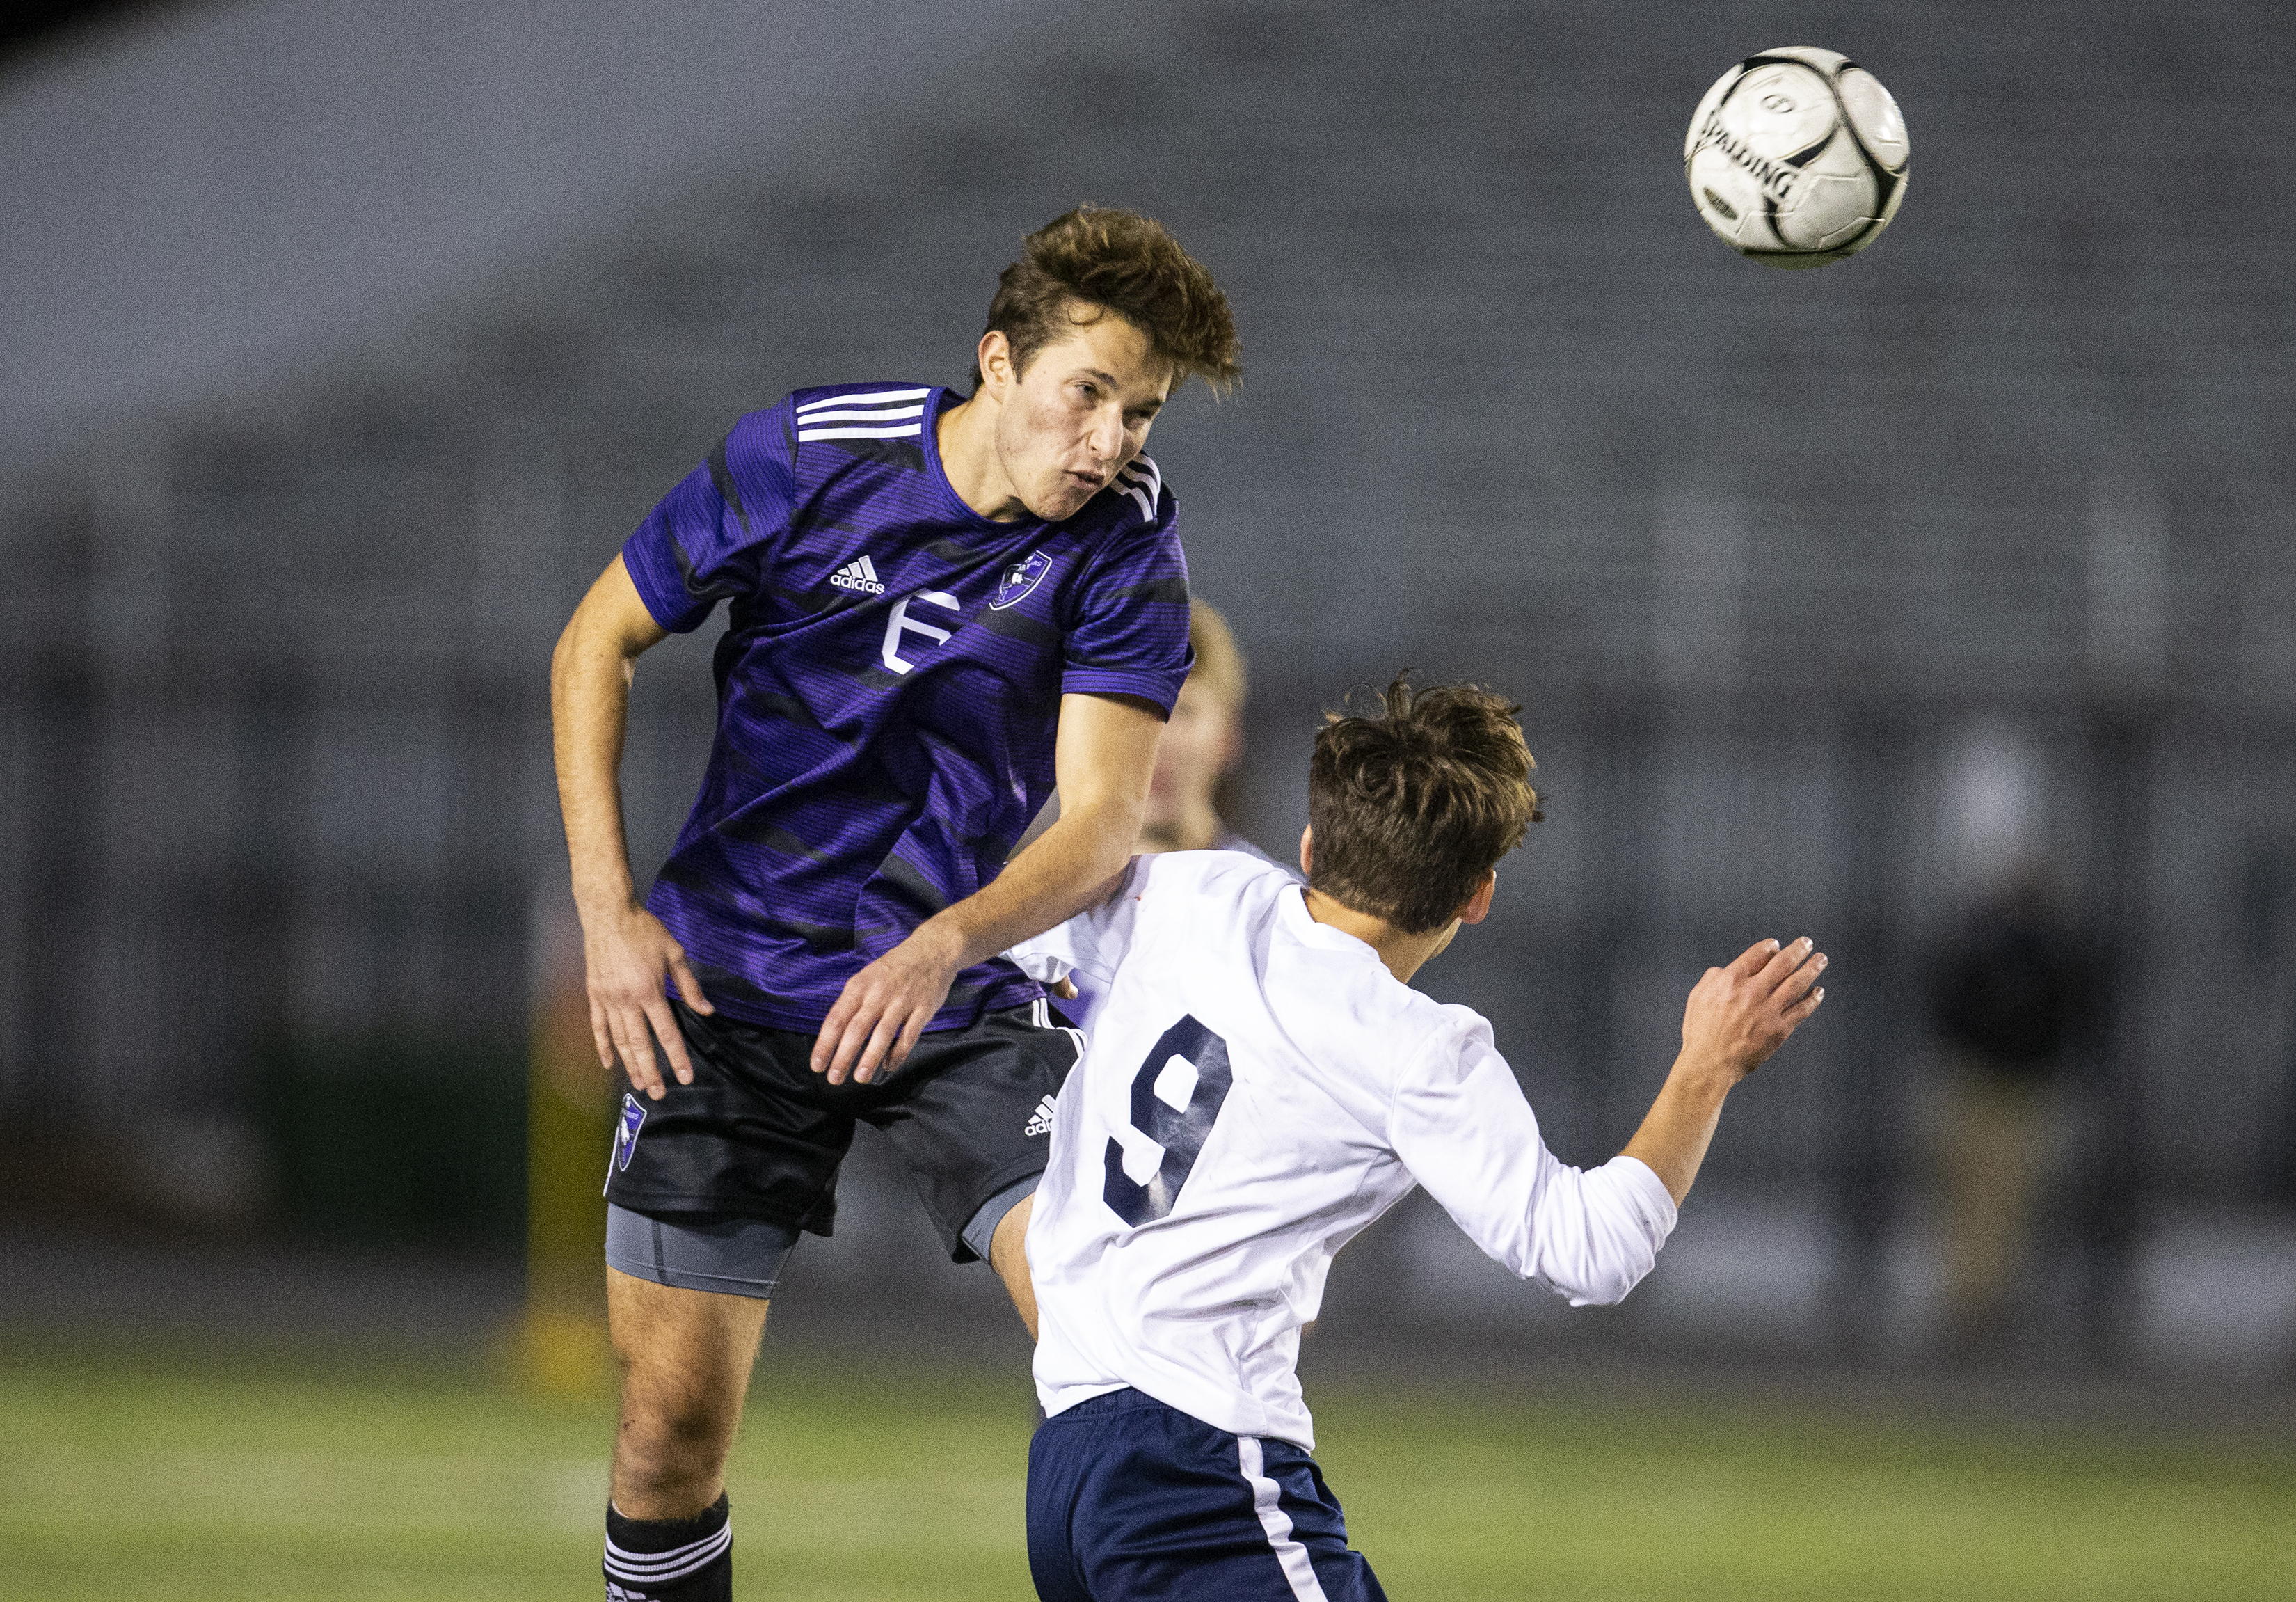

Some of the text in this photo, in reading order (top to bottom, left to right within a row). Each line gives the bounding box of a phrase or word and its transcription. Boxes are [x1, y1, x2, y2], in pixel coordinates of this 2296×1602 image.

[1700, 110, 1799, 198] SPALDING
[830, 573, 885, 594] adidas
[881, 589, 961, 675] 6
[1024, 1119, 1051, 1136] adi
[1103, 1013, 1234, 1228] 9
